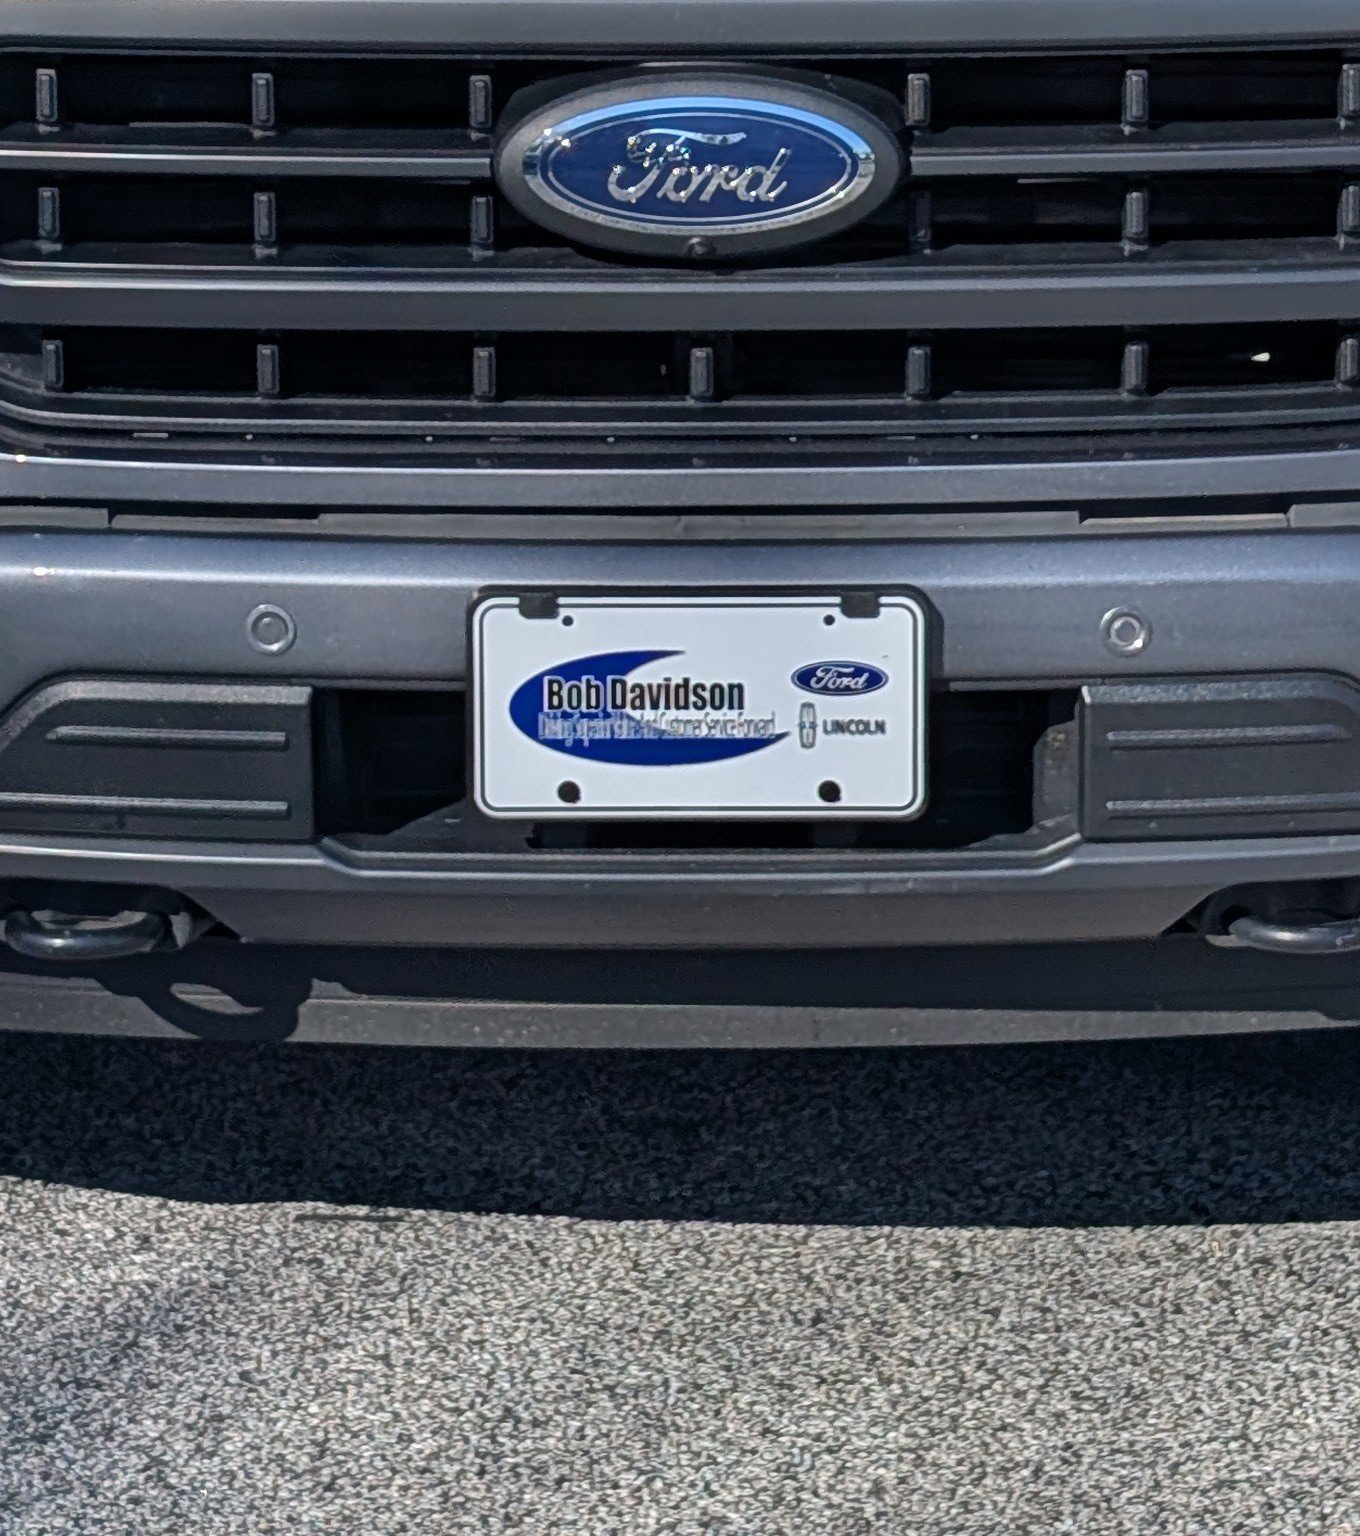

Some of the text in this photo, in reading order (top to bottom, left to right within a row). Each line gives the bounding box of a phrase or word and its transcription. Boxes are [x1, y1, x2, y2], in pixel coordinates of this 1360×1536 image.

[607, 127, 789, 203] Ford
[809, 666, 870, 690] Ford
[546, 676, 745, 711] Bob Davidson
[822, 719, 887, 735] LINCOLN
